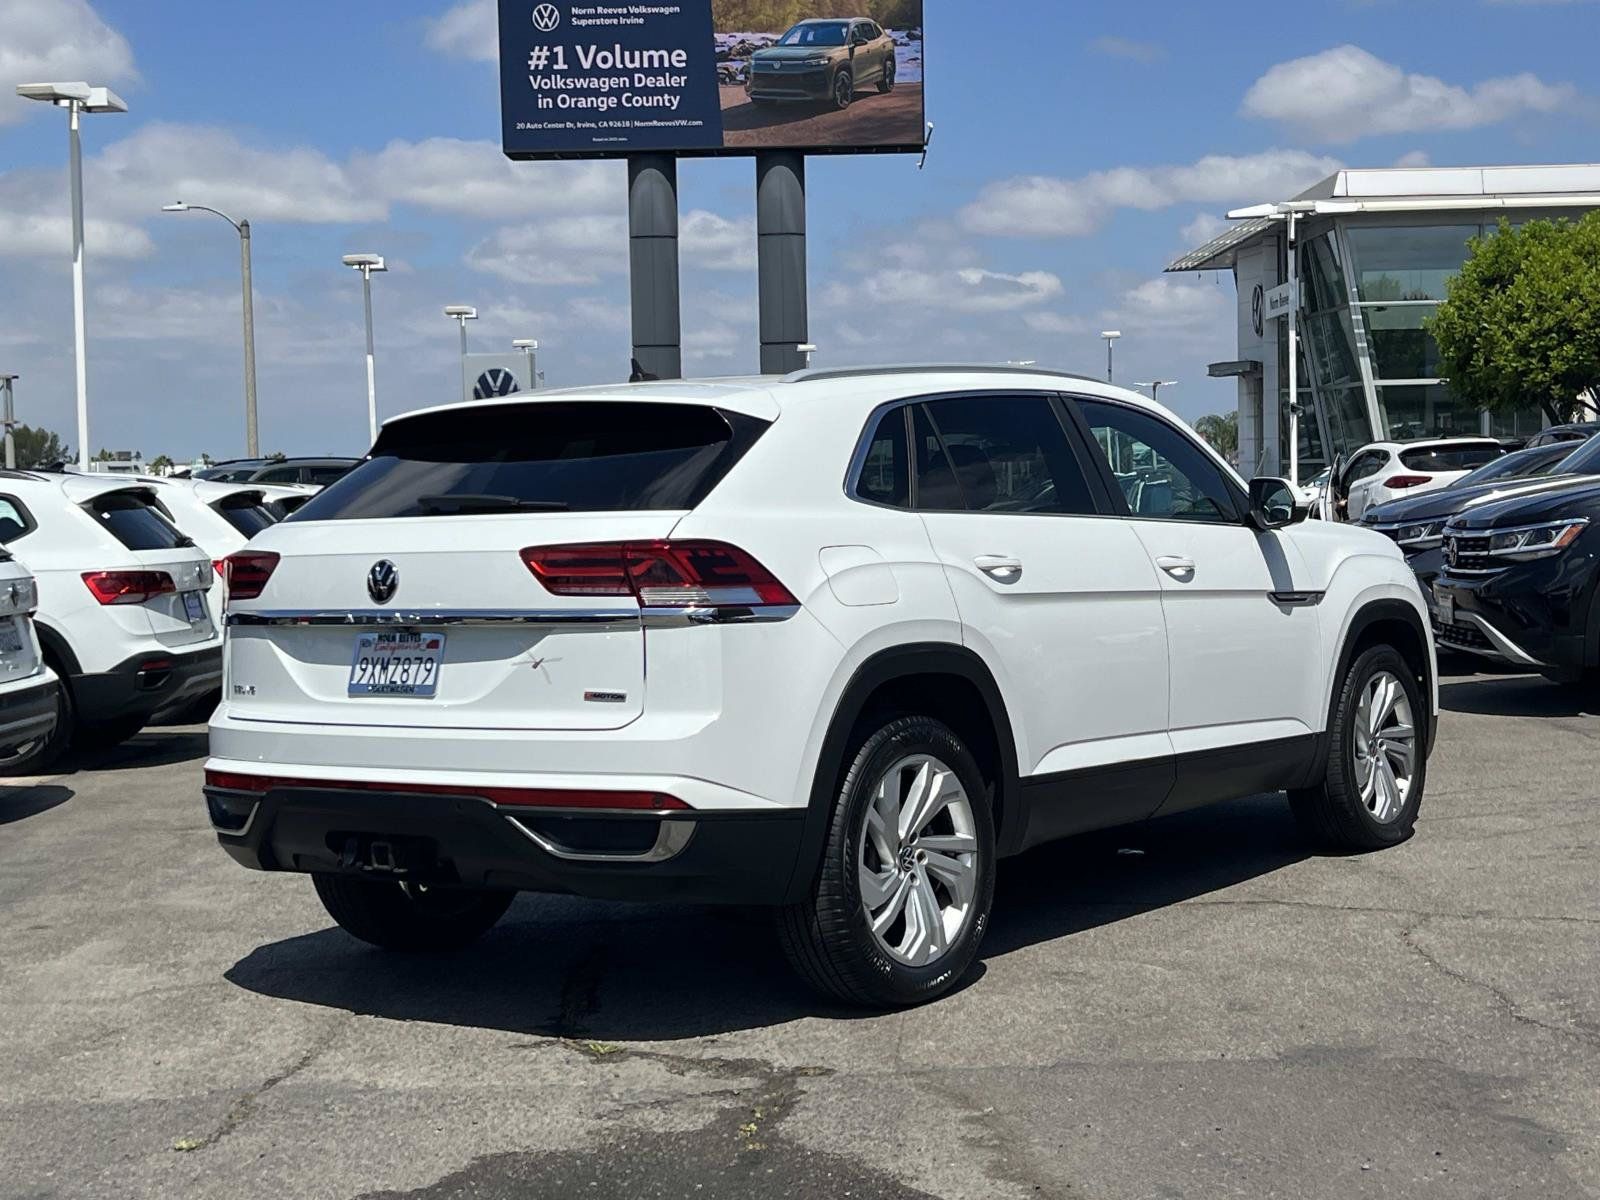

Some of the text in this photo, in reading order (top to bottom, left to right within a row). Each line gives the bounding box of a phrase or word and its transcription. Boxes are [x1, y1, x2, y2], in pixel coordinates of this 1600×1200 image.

[571, 7, 595, 15] Norm
[628, 6, 680, 15] Volkswagen
[571, 16, 644, 26] Superstore Irvine
[528, 44, 687, 70] #1 Volume
[529, 73, 687, 91] Volkswagen Dealer
[538, 92, 680, 111] in Orange County
[566, 121, 576, 129] Dr,
[609, 120, 630, 128] 92618
[357, 657, 434, 684] 9XMZ879
